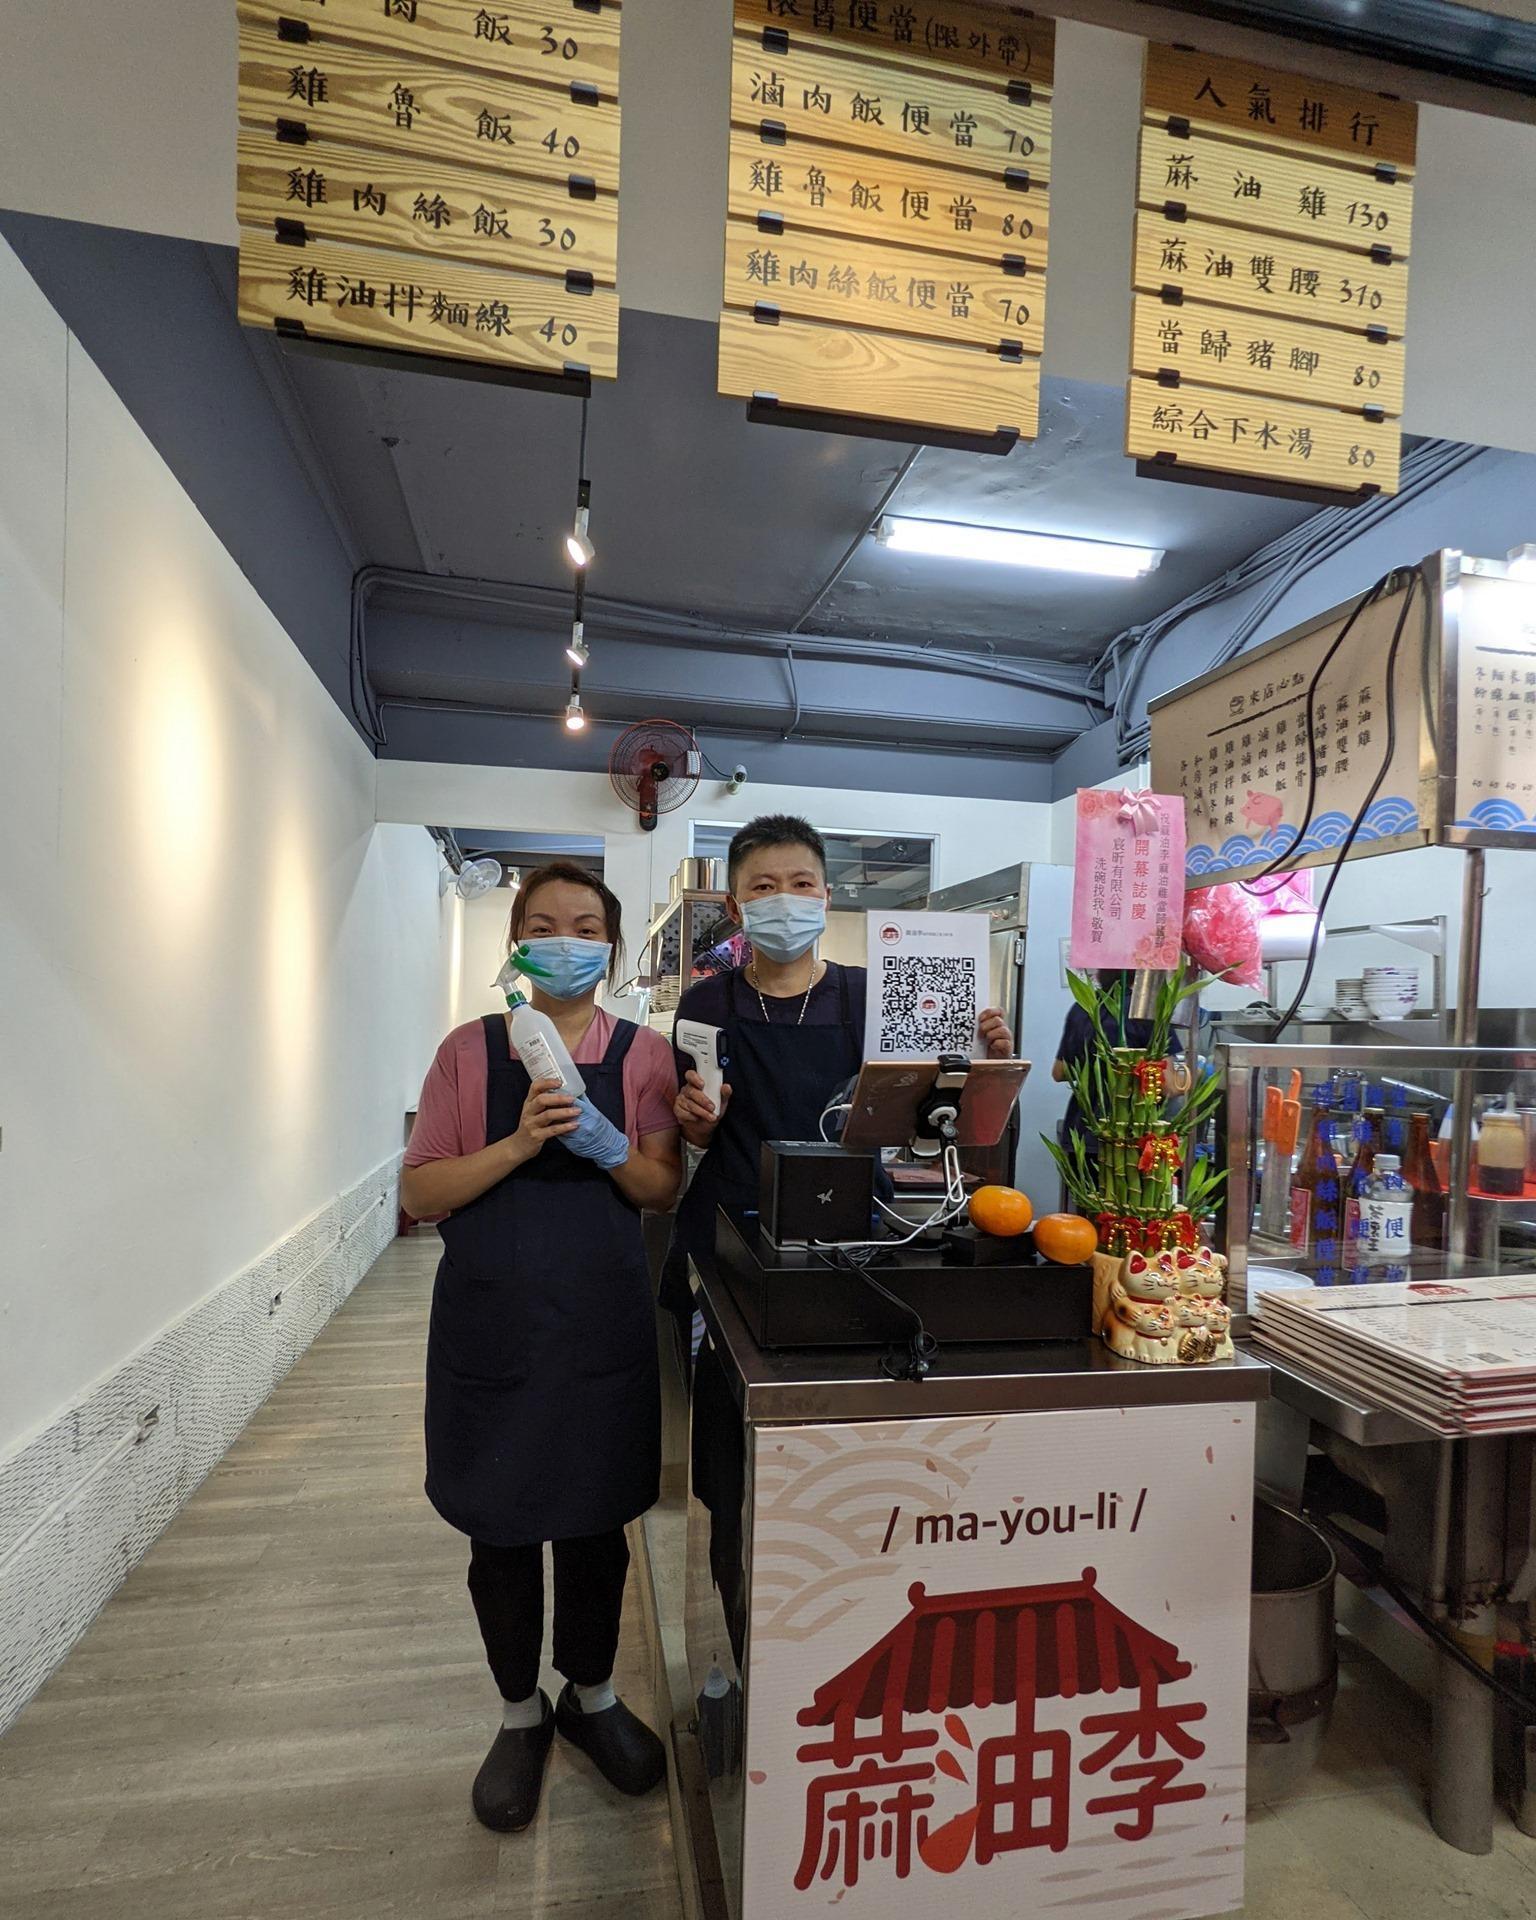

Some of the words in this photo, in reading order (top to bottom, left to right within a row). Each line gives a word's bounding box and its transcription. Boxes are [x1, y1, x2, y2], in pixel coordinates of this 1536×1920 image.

[310, 0, 514, 46] 肉飯
[540, 26, 578, 60] 30
[287, 65, 515, 145] 雞魯飯
[542, 128, 580, 158] 40
[750, 72, 978, 148] 滷肉飯便當
[1003, 130, 1035, 157] 70
[1194, 78, 1380, 147] 人氣排行
[286, 167, 512, 239] 雞肉絲飯
[539, 218, 576, 251] 30
[748, 160, 977, 232] 雞魯飯便當
[1002, 214, 1033, 239] 80
[1345, 202, 1389, 231] 130
[286, 266, 513, 338] 雞油拌麵線
[540, 317, 577, 346] 40
[745, 249, 974, 319] 雞肉絲飯便當
[999, 301, 1030, 326] 70
[1339, 280, 1382, 310] 310
[1157, 320, 1319, 375] 當歸豬腳
[1353, 365, 1380, 389] 80
[1153, 406, 1314, 460] 綜合下水湯
[1348, 445, 1375, 468] 80
[1131, 839, 1150, 920] 開幕誌慶
[915, 1492, 1117, 1544] ma-you-li
